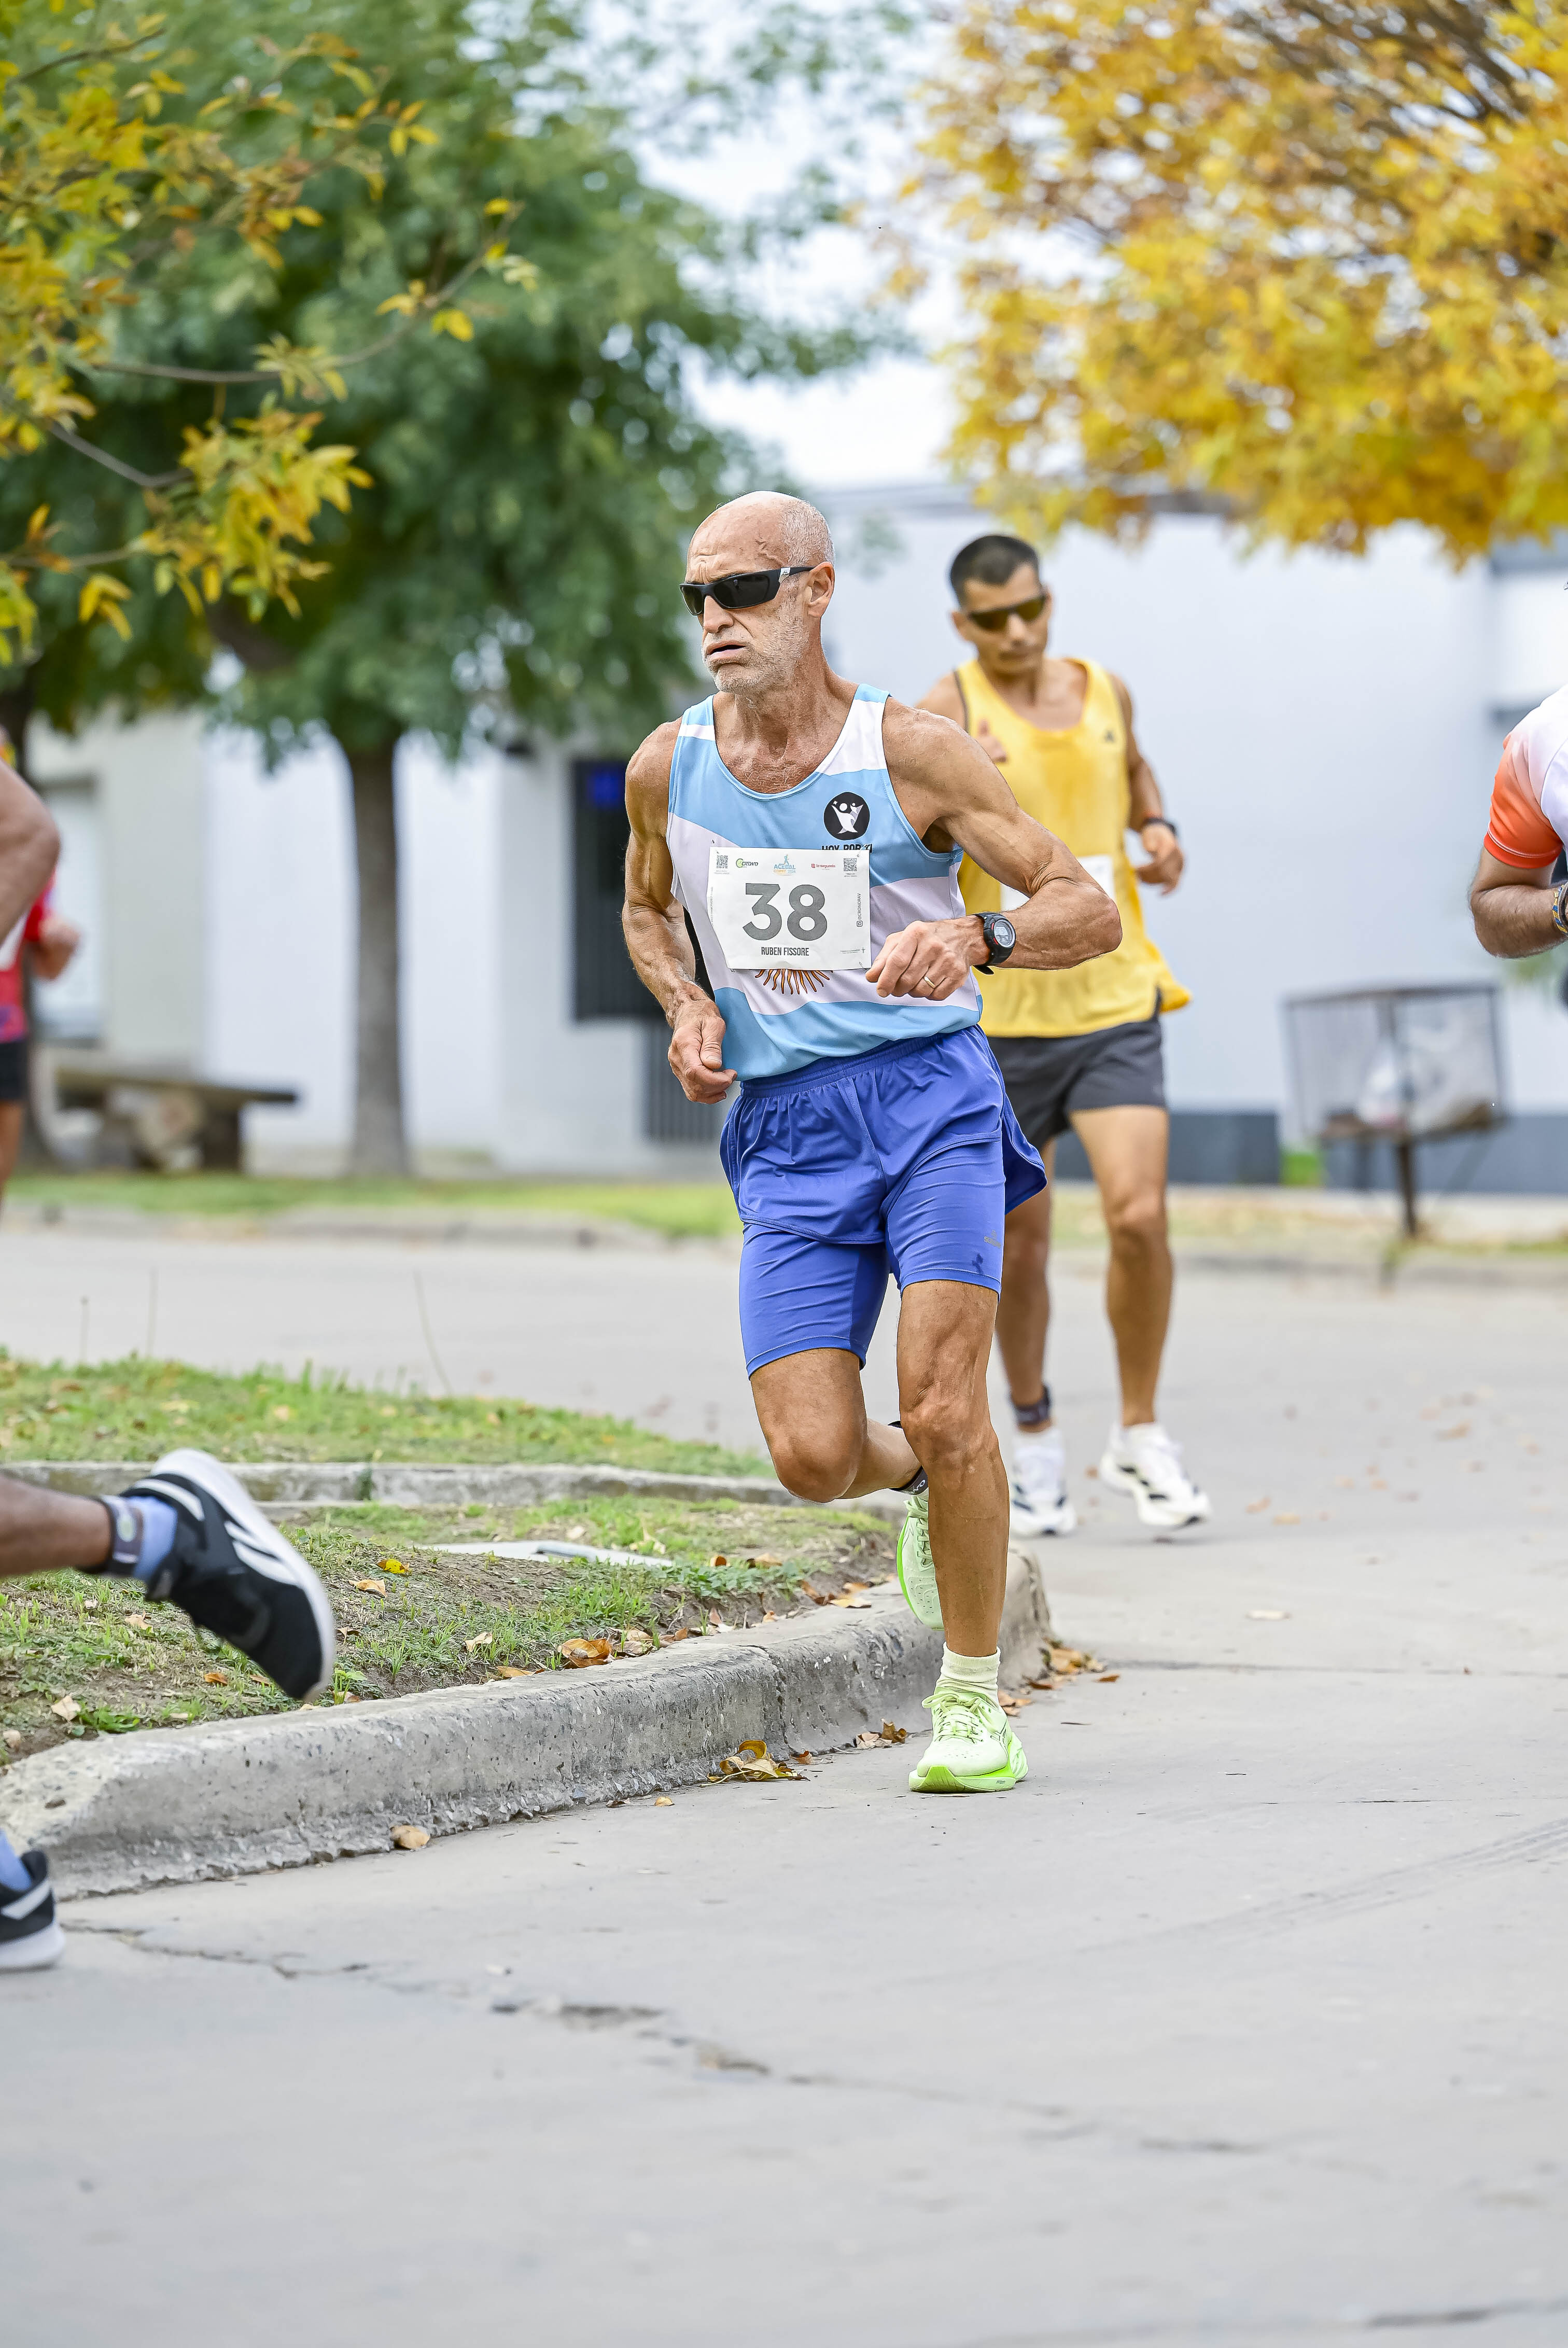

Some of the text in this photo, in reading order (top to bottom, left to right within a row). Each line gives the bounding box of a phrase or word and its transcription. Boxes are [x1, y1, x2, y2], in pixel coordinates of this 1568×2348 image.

[743, 883, 828, 941] 38
[761, 947, 809, 956] RUBEN FISSORE
